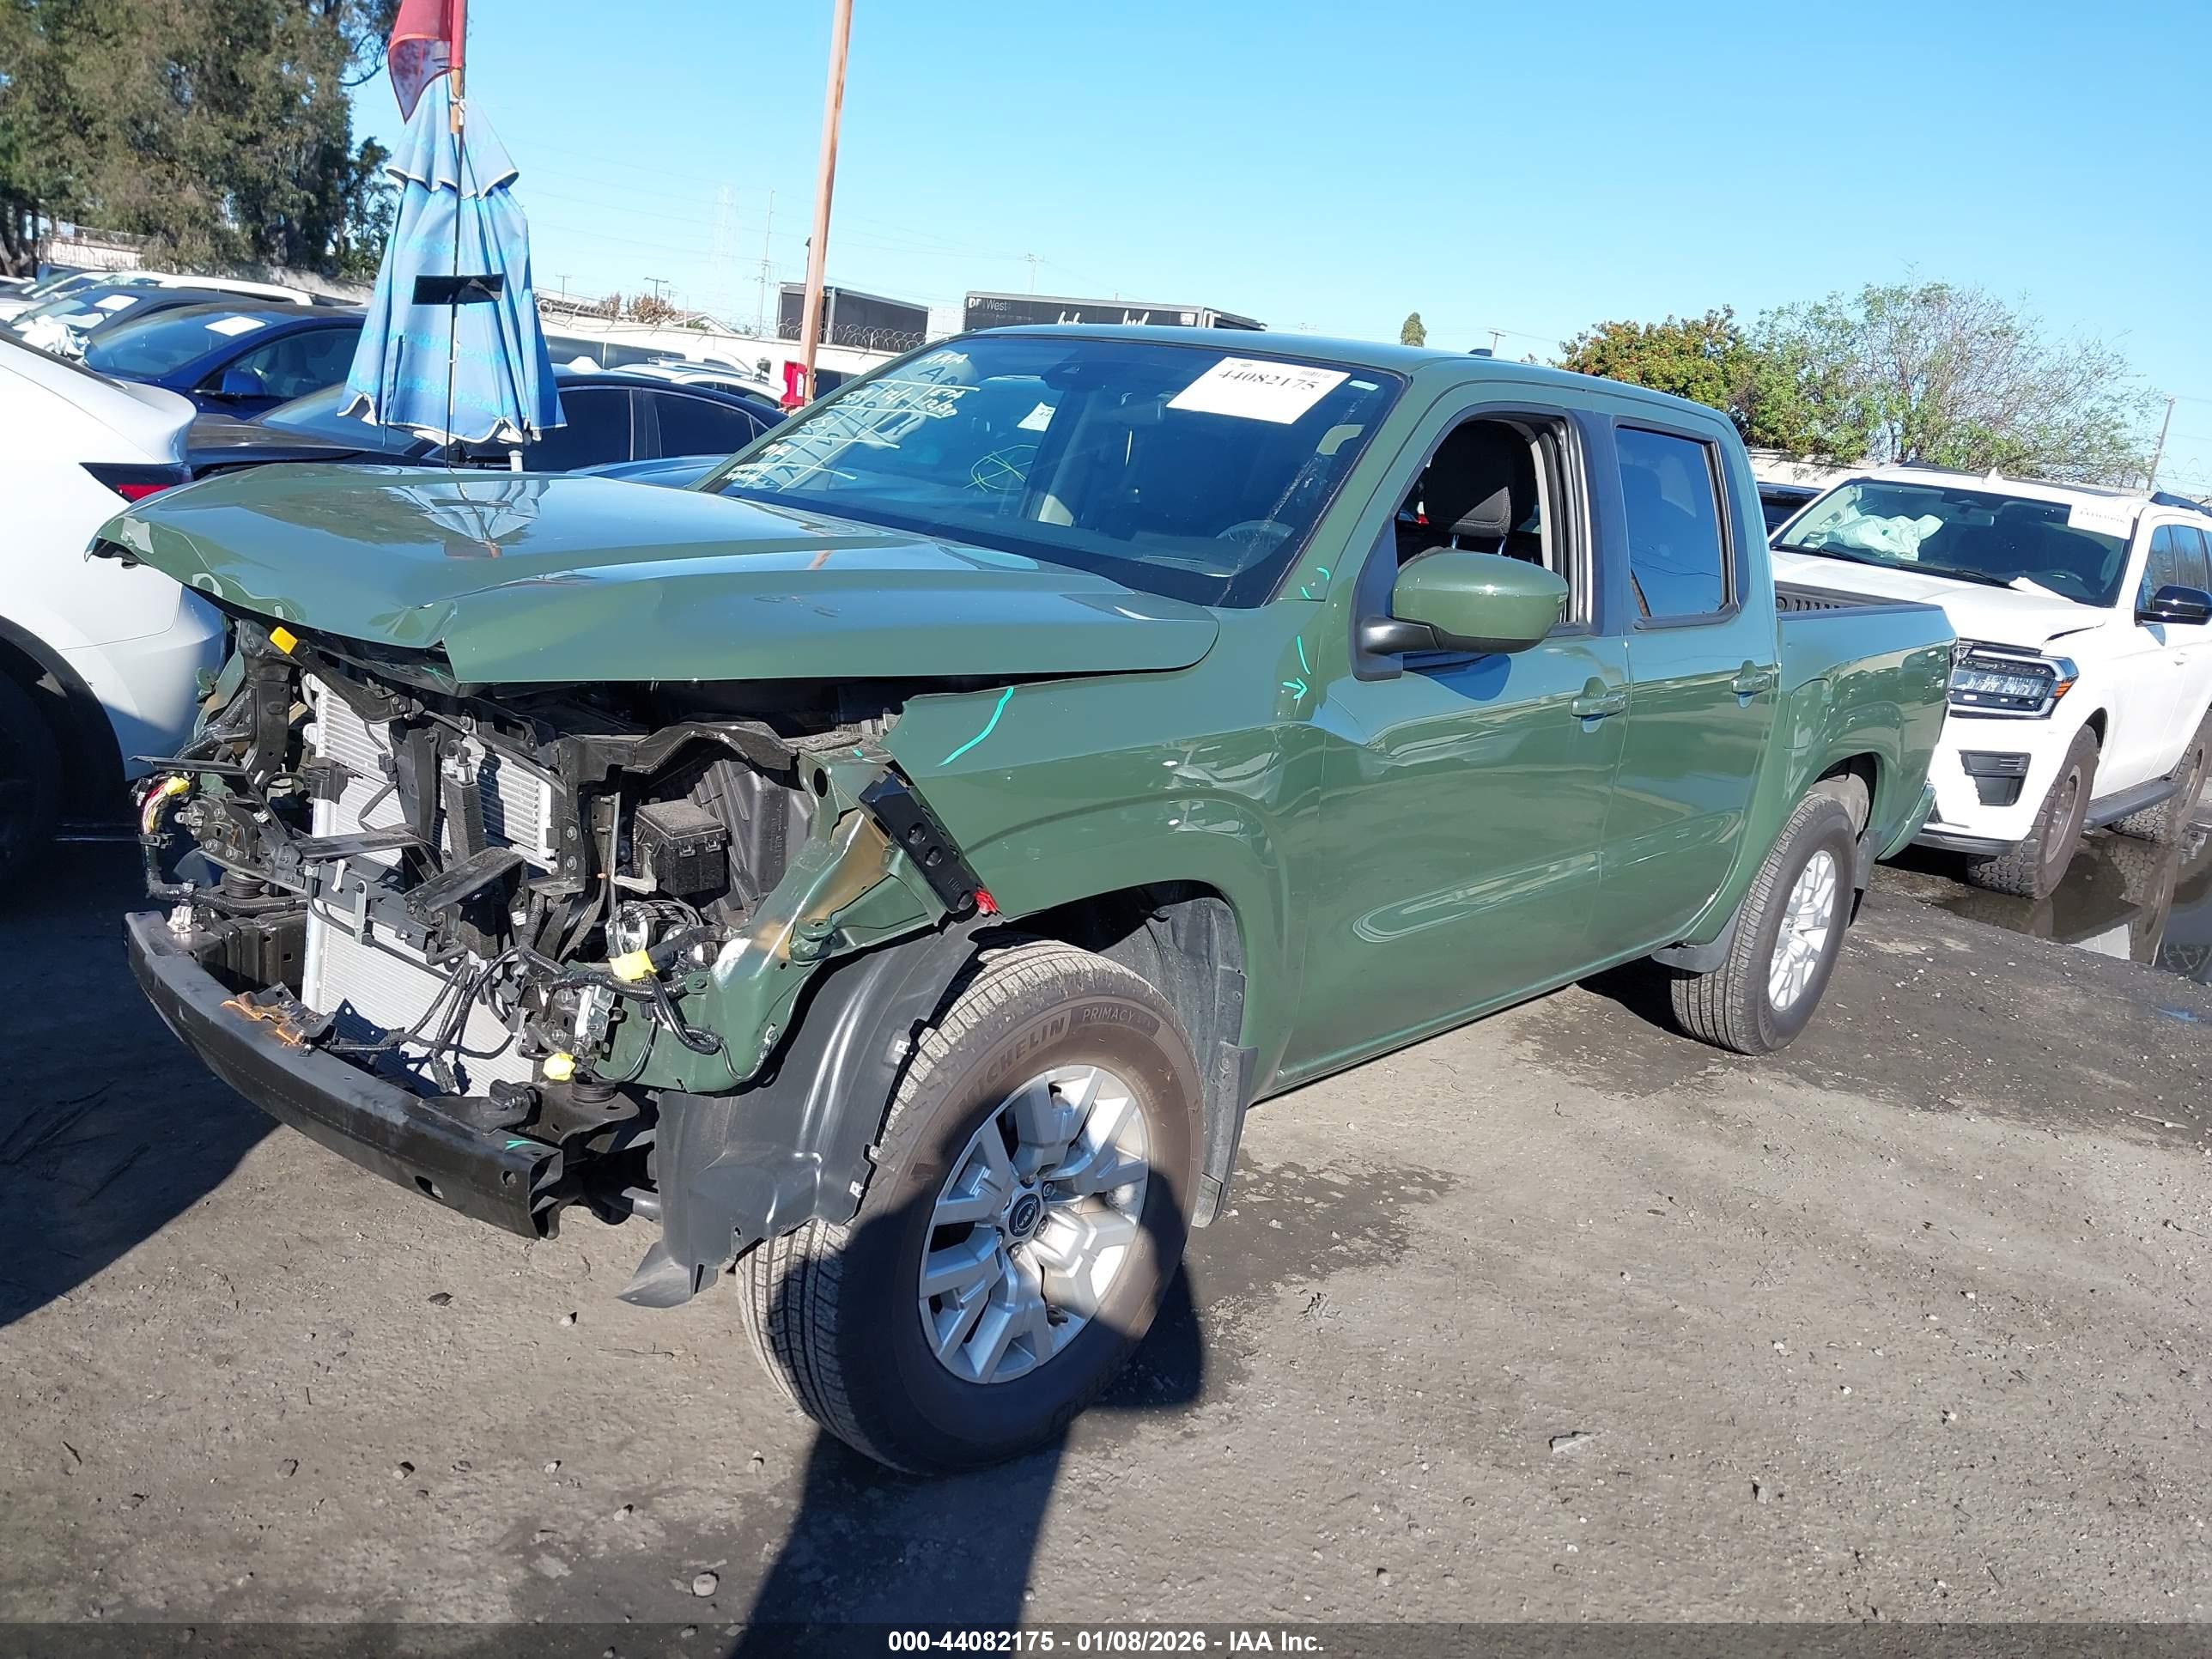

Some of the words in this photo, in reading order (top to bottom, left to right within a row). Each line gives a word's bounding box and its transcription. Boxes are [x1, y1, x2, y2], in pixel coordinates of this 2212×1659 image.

[987, 299, 1008, 312] West
[1218, 369, 1321, 391] 44082175
[1082, 1006, 1135, 1023] PRIMACY
